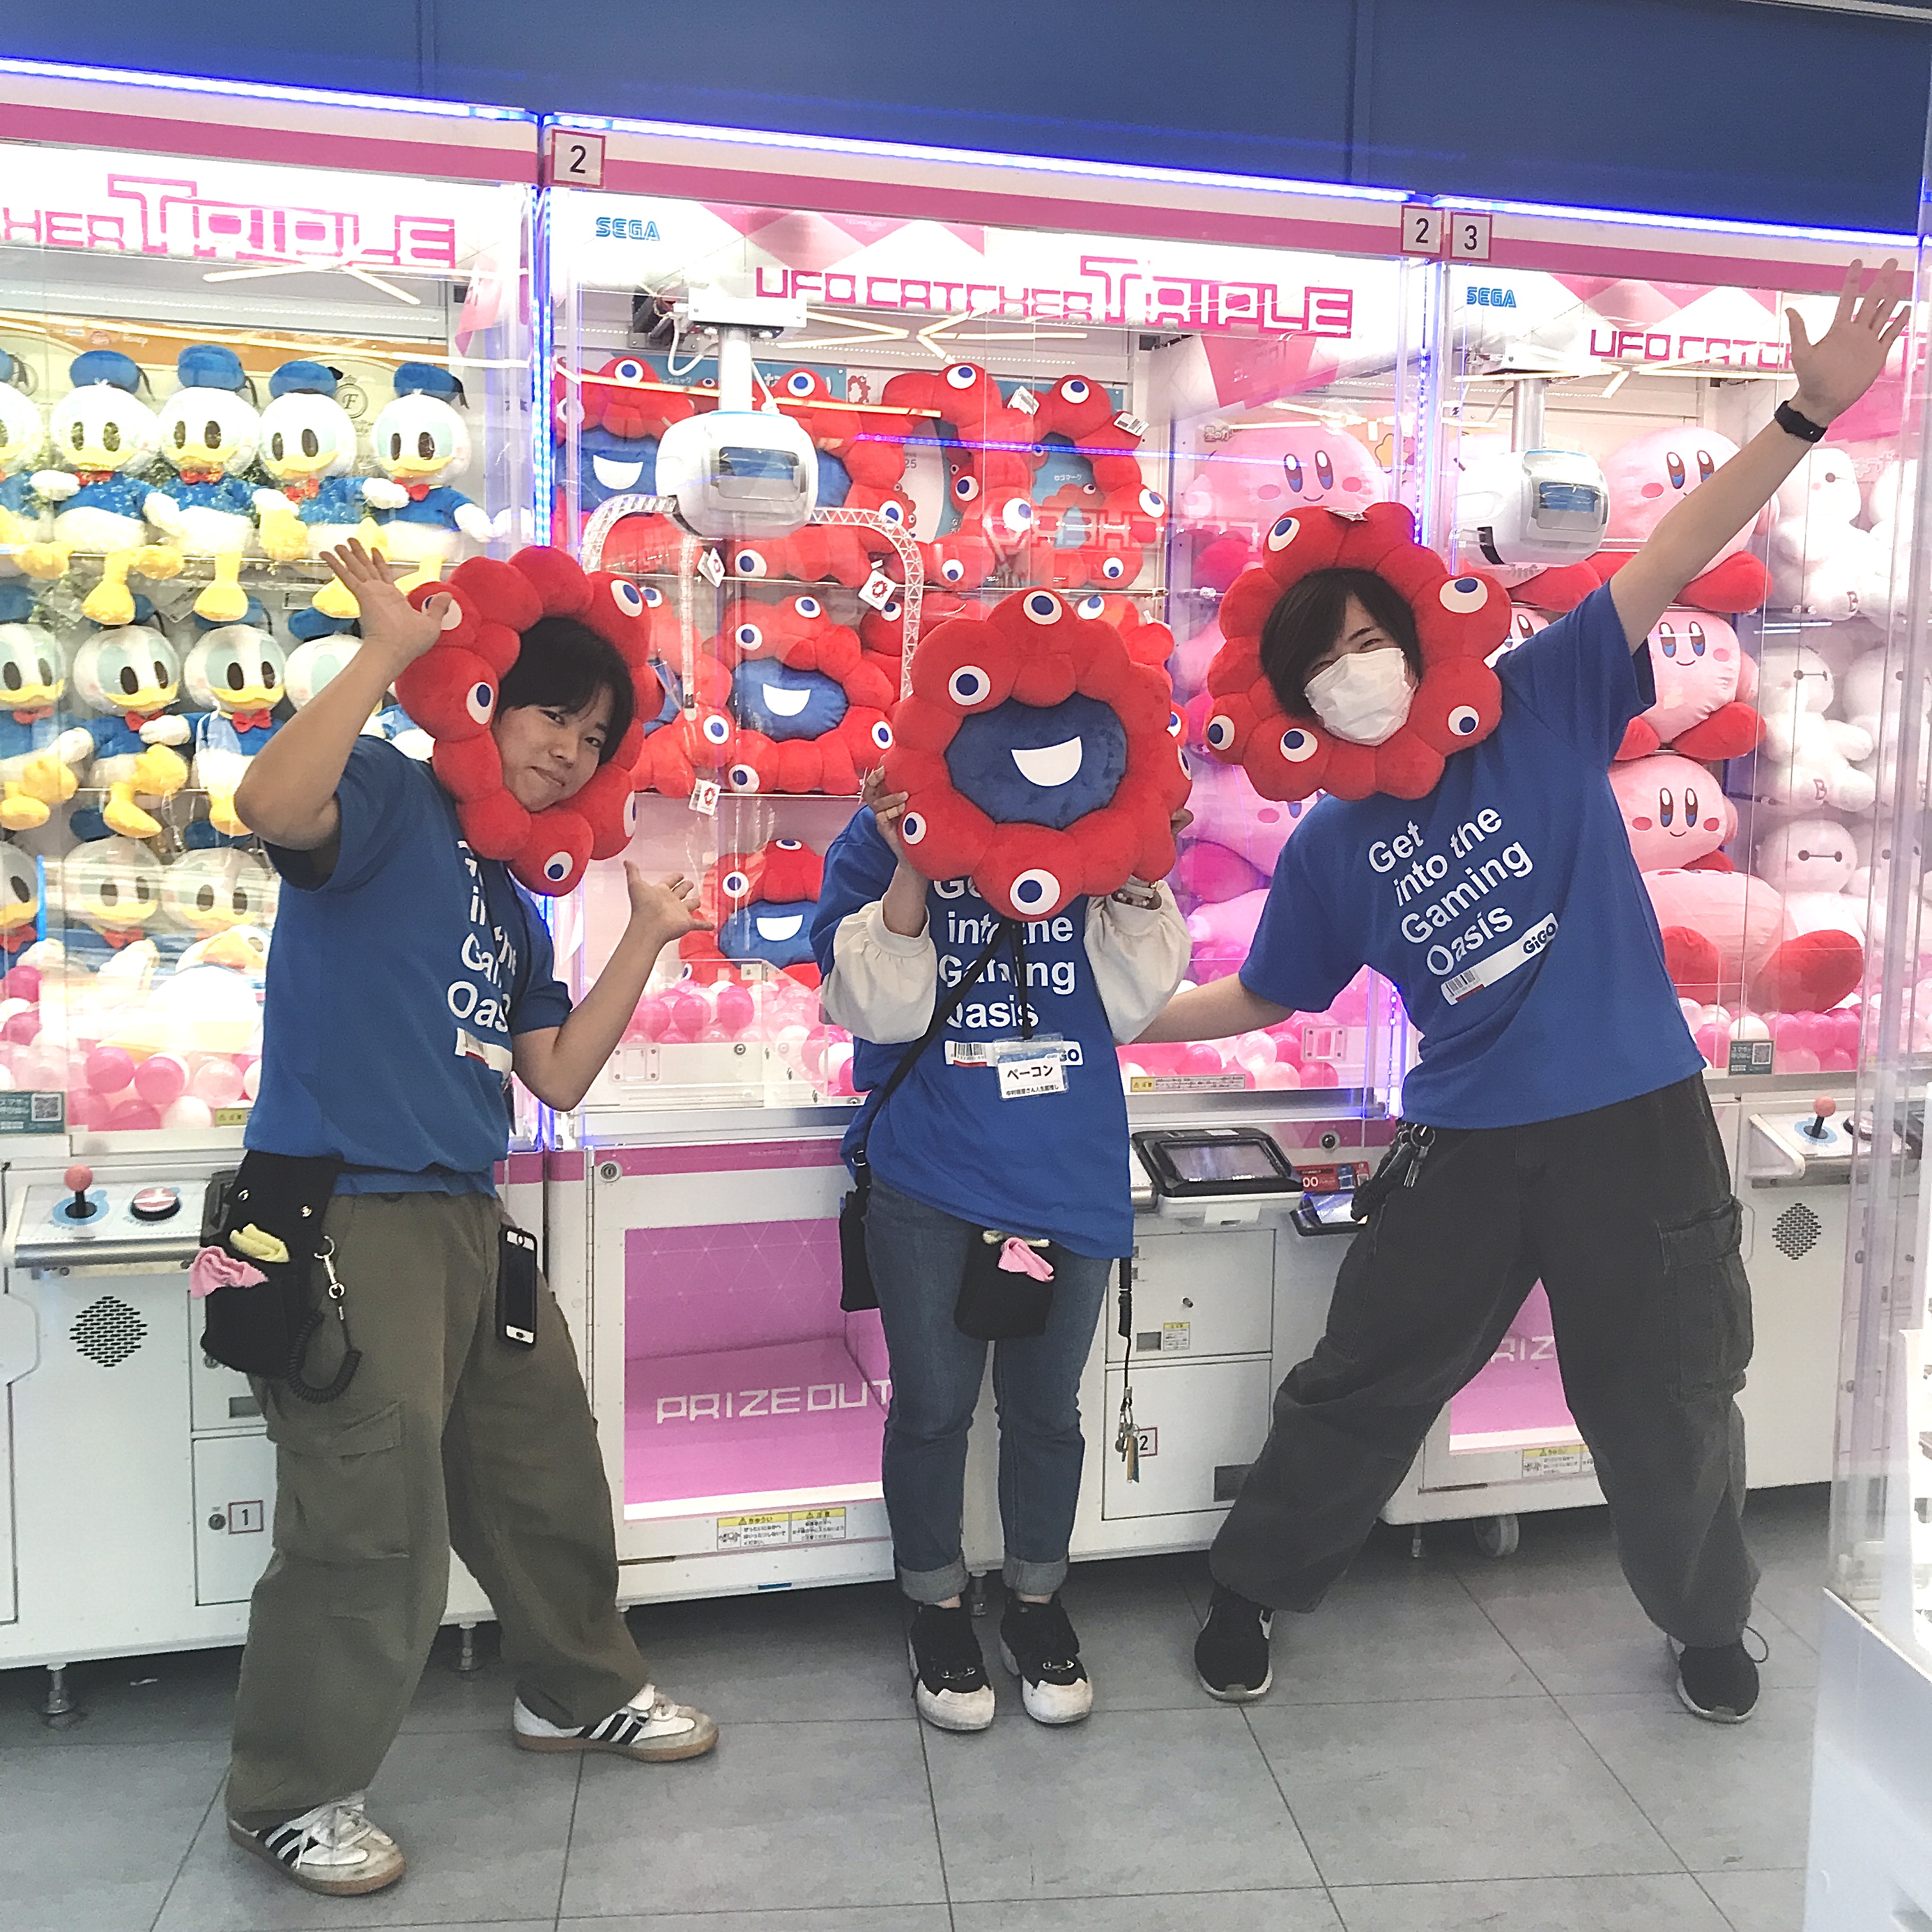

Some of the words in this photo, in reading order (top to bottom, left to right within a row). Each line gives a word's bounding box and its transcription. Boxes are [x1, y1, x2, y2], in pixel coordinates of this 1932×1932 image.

[570, 145, 586, 174] 2
[595, 217, 661, 241] SEGA
[1415, 218, 1429, 243] 2
[1464, 225, 1477, 250] 3
[1466, 286, 1517, 308] SEGA
[1813, 778, 1828, 801] B
[1368, 820, 1424, 873] Get
[1393, 854, 1448, 907] into
[1450, 808, 1503, 859] the
[1400, 841, 1534, 944] Gaming
[1022, 916, 1073, 945] he
[1426, 907, 1514, 976] Oasis
[1522, 923, 1556, 954] GiGO
[1007, 1065, 1054, 1080] ベーコン
[1139, 1435, 1148, 1451] 2
[241, 1508, 249, 1526] 1
